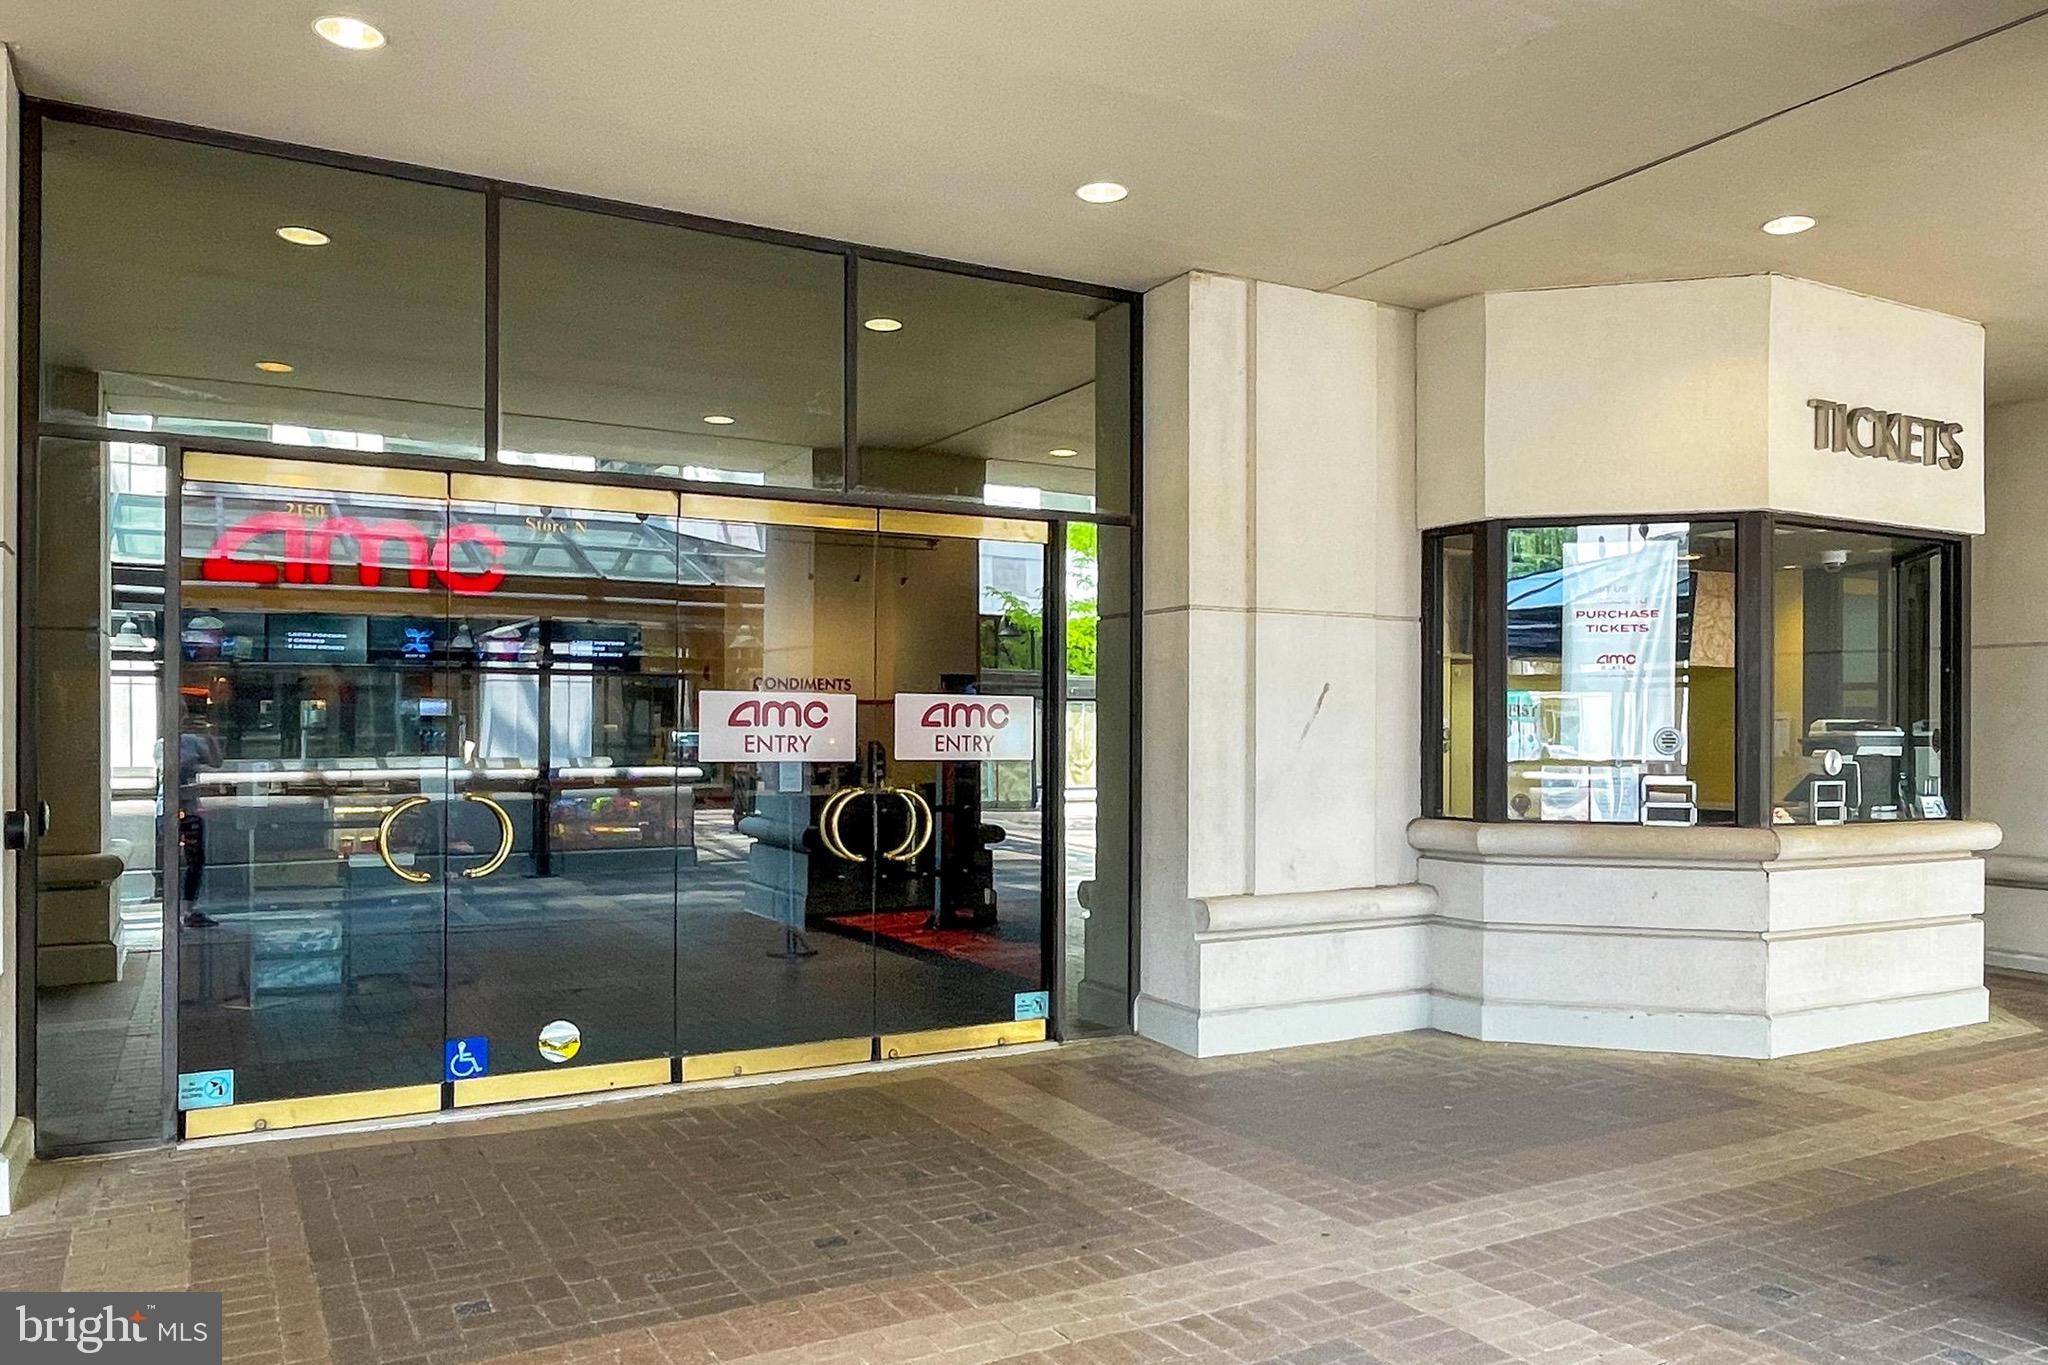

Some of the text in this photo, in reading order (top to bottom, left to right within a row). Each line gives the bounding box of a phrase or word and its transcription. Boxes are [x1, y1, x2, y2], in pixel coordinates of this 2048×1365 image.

[1806, 398, 1964, 471] TICKETS
[525, 516, 588, 534] Store N
[1575, 609, 1660, 619] PURCHASE
[1586, 623, 1650, 633] TICKETS
[753, 677, 853, 692] CONDIMENTS
[743, 734, 812, 753] ENTRY
[934, 734, 995, 752] ENTRY
